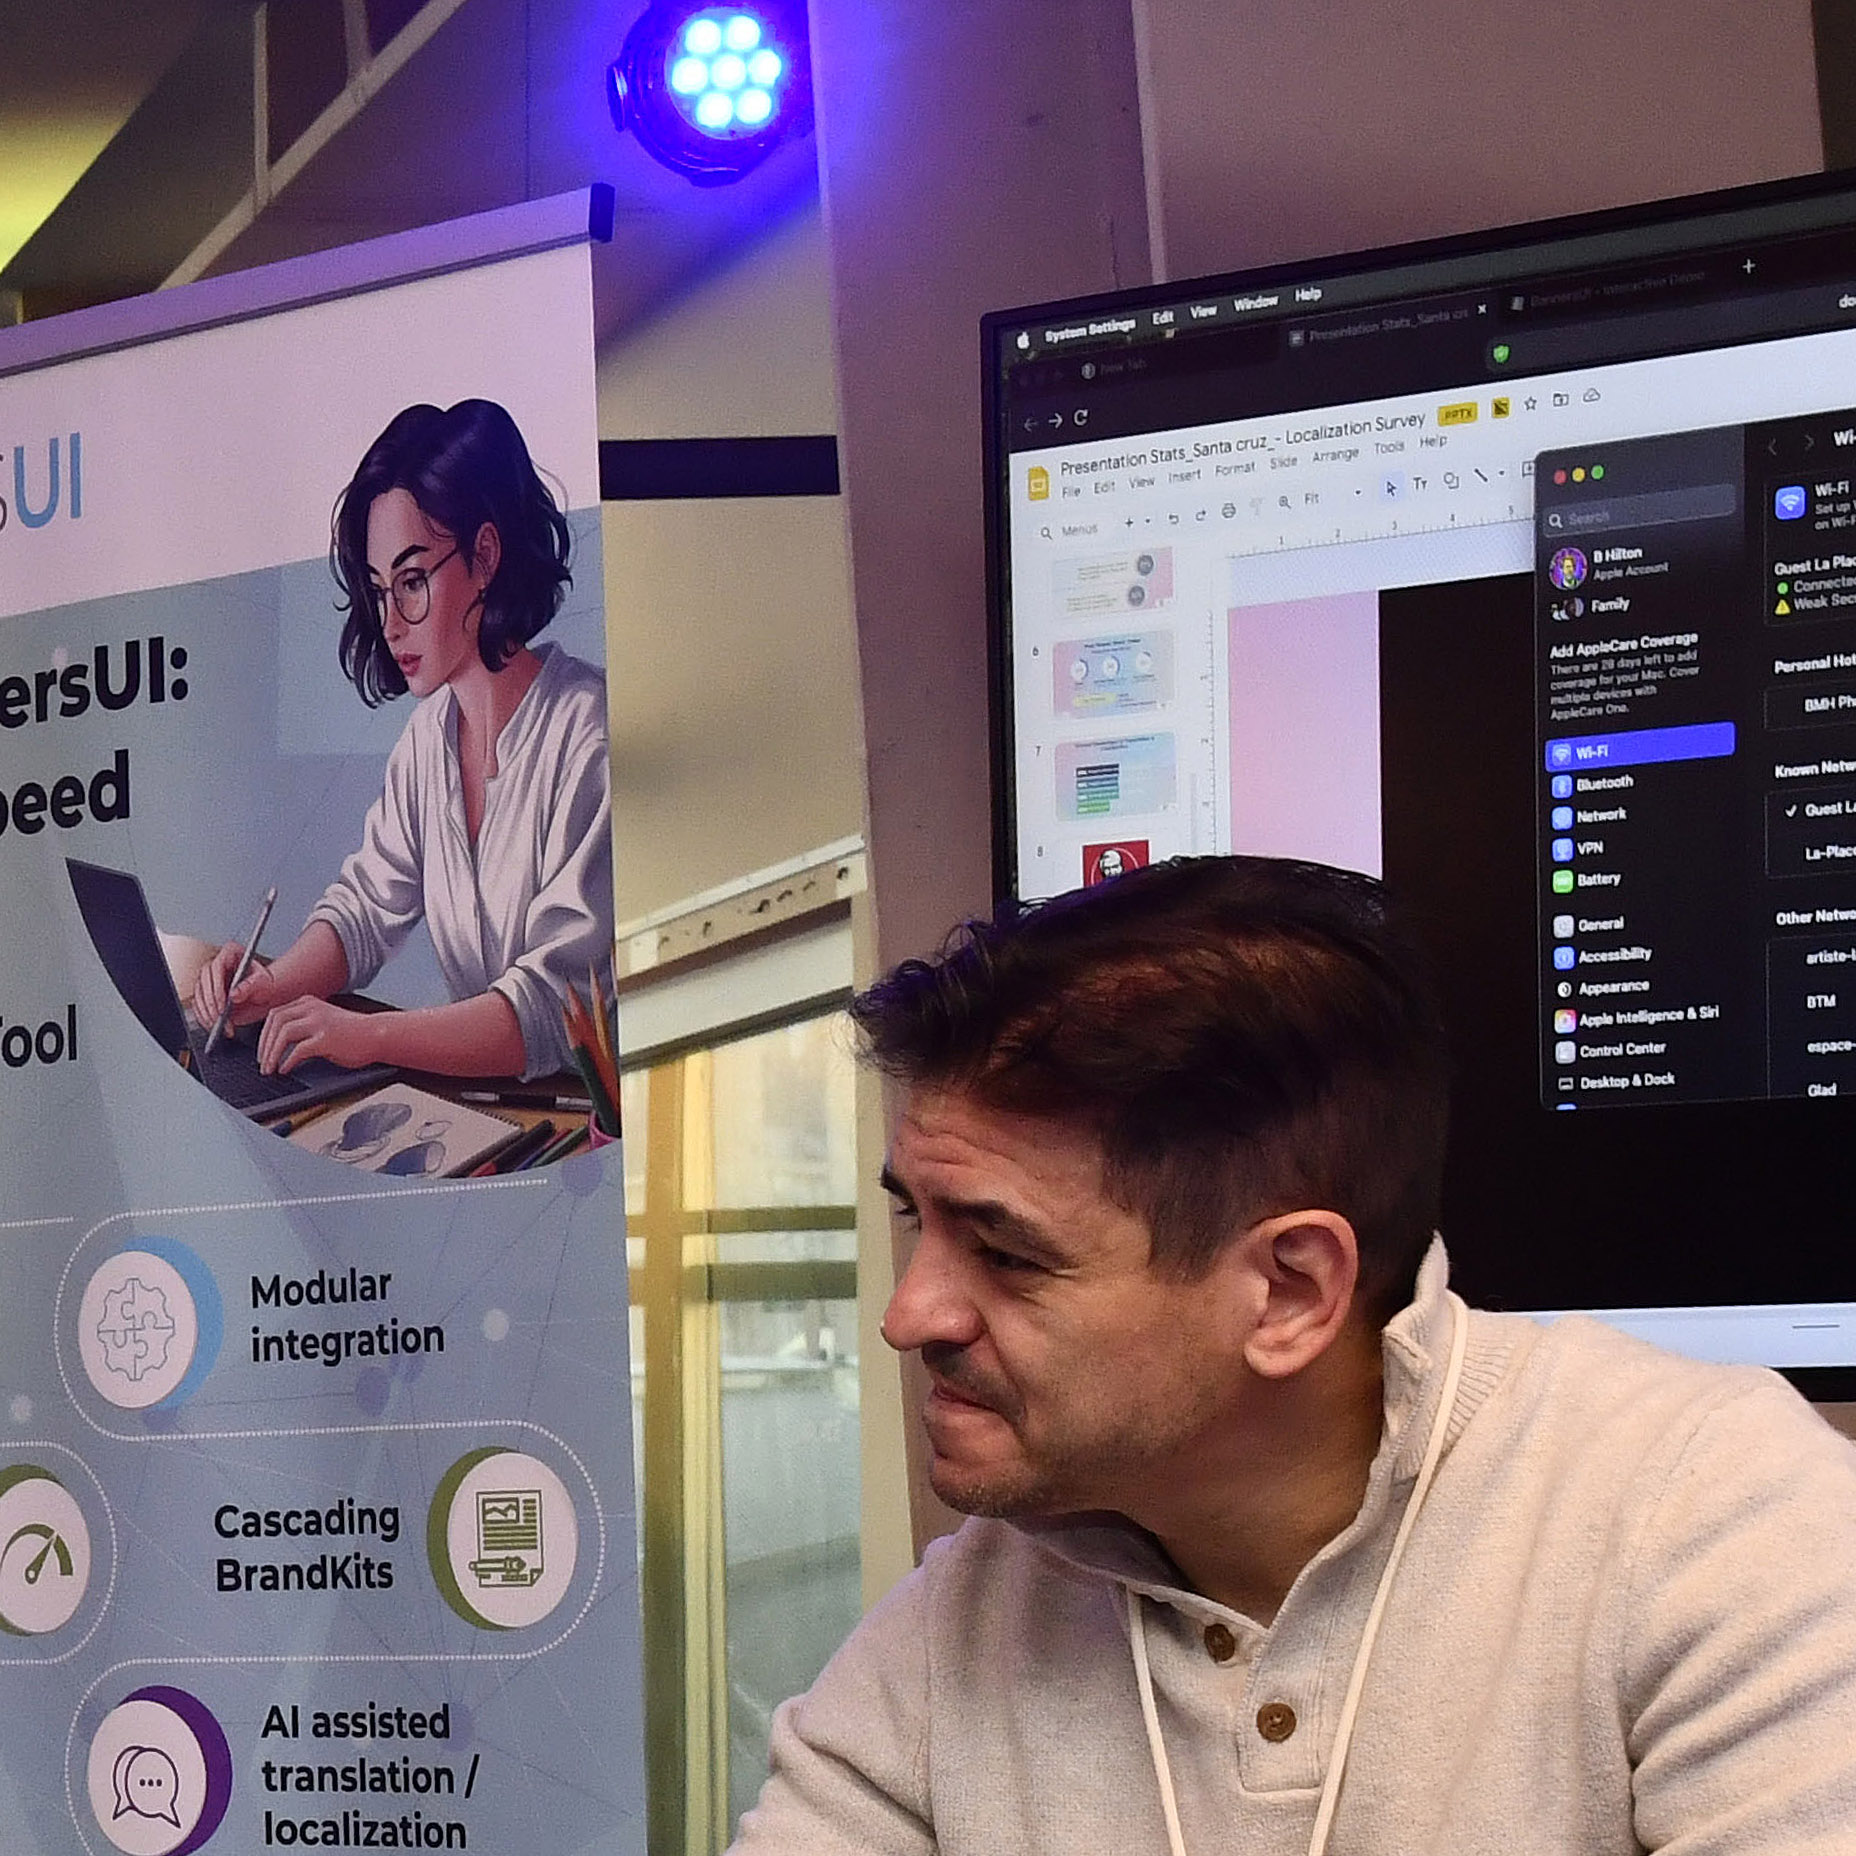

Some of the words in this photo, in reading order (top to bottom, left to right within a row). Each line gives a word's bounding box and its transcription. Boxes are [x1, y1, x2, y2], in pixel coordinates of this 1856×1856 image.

[1045, 326, 1087, 343] System
[1088, 318, 1136, 336] Settings
[1152, 310, 1175, 326] Edit
[1190, 303, 1218, 319] View
[1233, 294, 1279, 312] Window
[1294, 287, 1322, 303] Help
[1060, 451, 1148, 477] Presentation
[1150, 440, 1233, 466] Stats_Santa
[1286, 418, 1372, 445] Localization
[1375, 411, 1426, 434] Survey
[1062, 485, 1081, 498] File
[1094, 480, 1116, 494] Edit
[1129, 475, 1155, 489] View
[1168, 468, 1201, 485] Insert
[1215, 461, 1256, 478] Format
[1270, 454, 1298, 470] Slide
[1312, 446, 1359, 465] Arrange
[1374, 440, 1405, 455] Tools
[1420, 434, 1448, 450] Help
[1815, 480, 1850, 497] Wi-Fi
[1305, 491, 1320, 505] Fit
[1605, 547, 1643, 562] Hilton
[1593, 567, 1623, 581] Apple
[1626, 561, 1670, 578] Account
[1591, 596, 1631, 613] Family
[1550, 645, 1575, 659] Add
[1576, 638, 1639, 657] AppleCare
[1640, 632, 1699, 650] Coverage
[1774, 656, 1831, 675] Personal
[1576, 743, 1609, 760] Wi-Fi
[1775, 762, 1819, 779] Known
[1576, 774, 1634, 792] Bluetooth
[1577, 807, 1627, 824] Network
[1577, 840, 1604, 855] VPN
[1578, 872, 1622, 888] Battery
[1578, 916, 1625, 932] General
[1776, 910, 1813, 926] Other
[1578, 947, 1653, 965] Accessibility
[1578, 979, 1651, 996] Appearance
[1579, 1012, 1614, 1028] Apple
[1616, 1008, 1685, 1026] Intelligence
[1699, 1004, 1720, 1019] Siri
[1579, 1043, 1624, 1059] Control
[1626, 1041, 1668, 1057] Center
[1580, 1075, 1630, 1092] Desktop
[1644, 1071, 1676, 1087] Dock
[249, 1268, 393, 1310] Modular
[249, 1316, 446, 1365] integration
[213, 1500, 402, 1546] Cascading
[214, 1554, 395, 1593] BrandKits
[260, 1703, 302, 1741] AI
[311, 1701, 452, 1740] assisted
[260, 1756, 456, 1797] translation
[463, 1753, 480, 1799] /
[263, 1810, 469, 1850] localization
